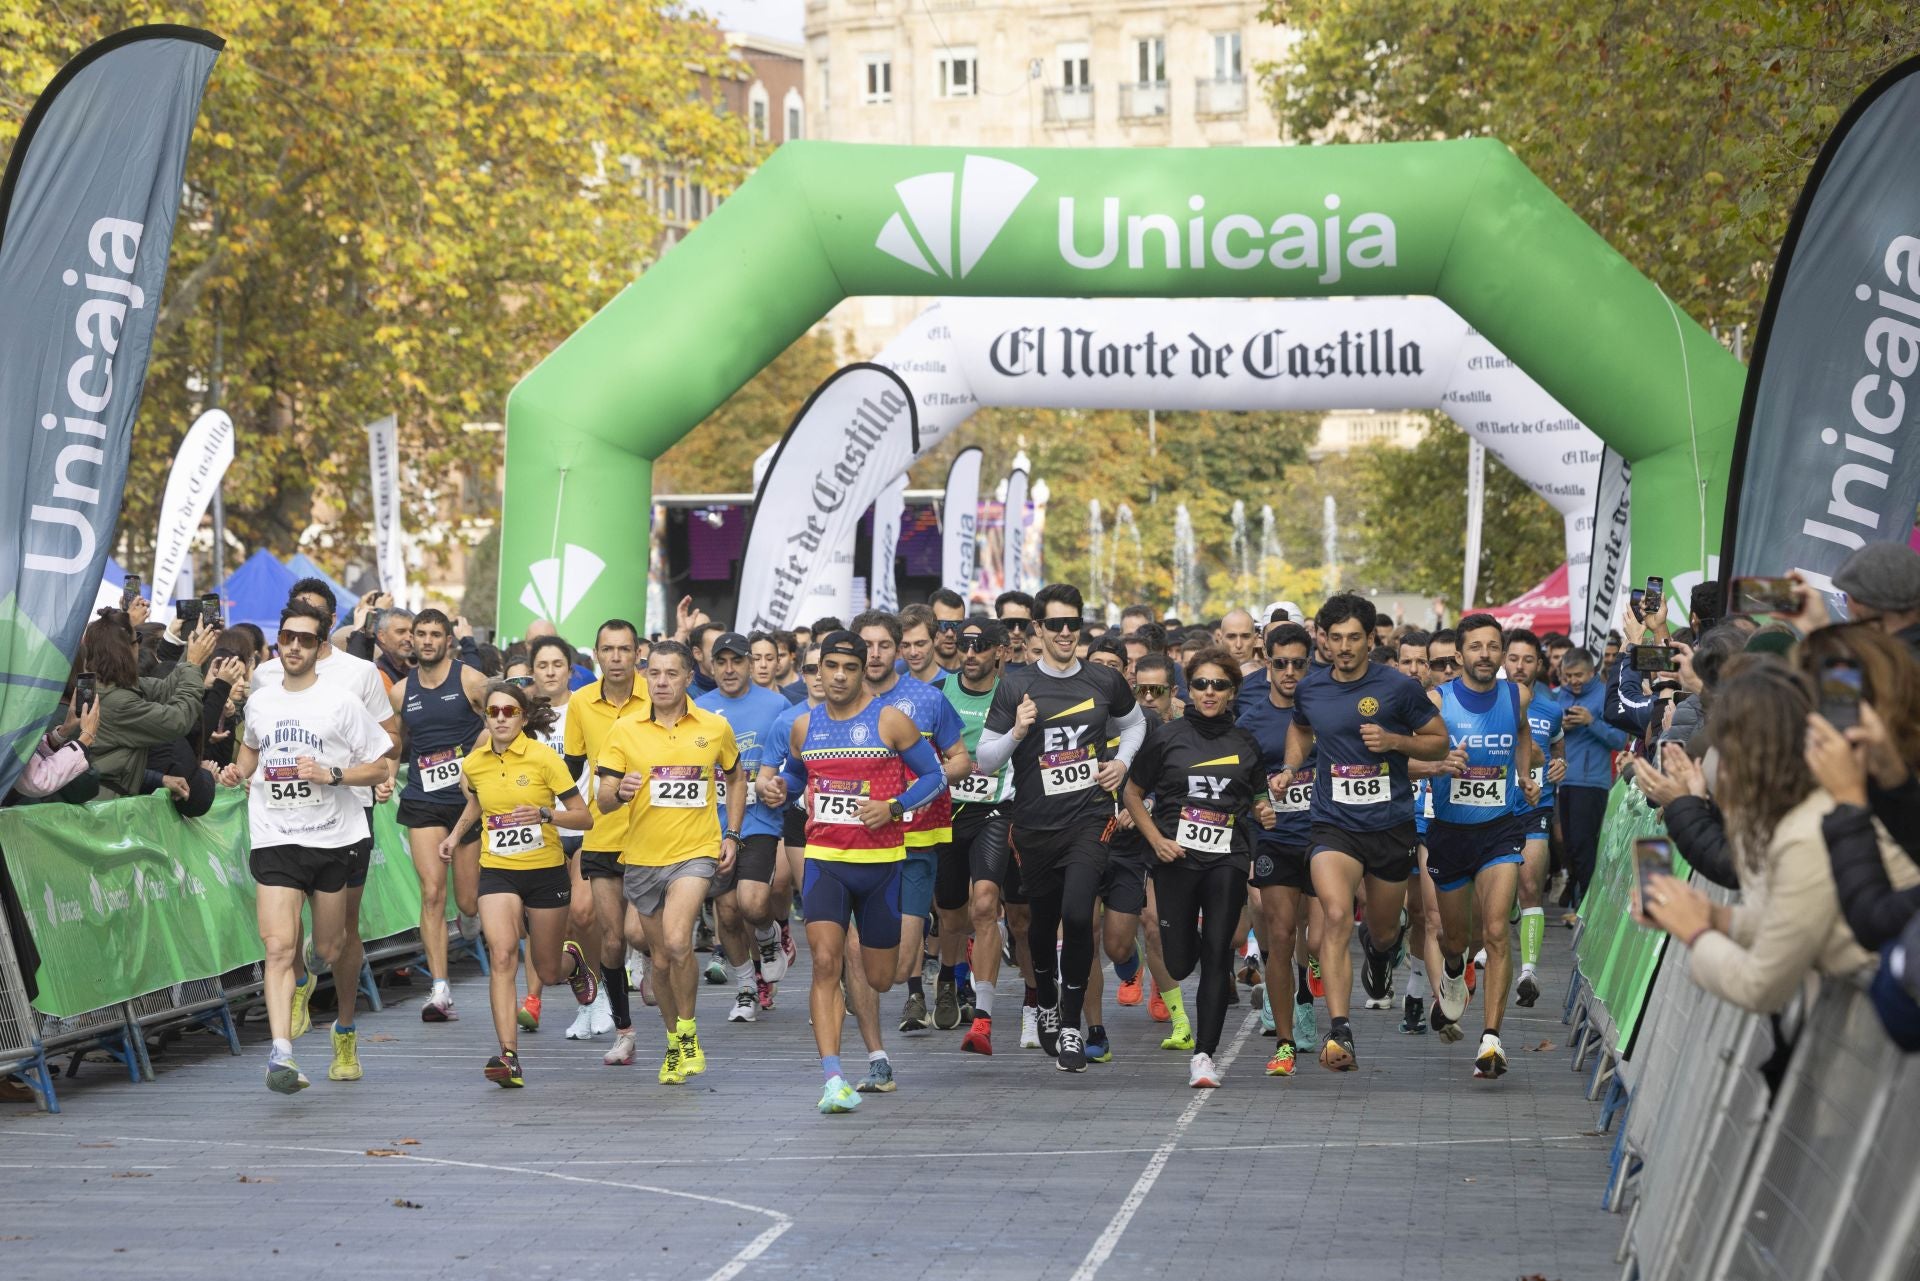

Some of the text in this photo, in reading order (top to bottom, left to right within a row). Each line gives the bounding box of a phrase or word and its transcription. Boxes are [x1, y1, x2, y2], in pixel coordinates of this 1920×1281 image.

[1058, 193, 1398, 285] Unicaja
[990, 326, 1426, 380] El Norte de Castilla
[24, 216, 145, 575] Unicaja
[1449, 390, 1492, 403] Castilla
[1476, 418, 1581, 435] El Norte de Castilla
[190, 420, 231, 495] Castilla
[1562, 450, 1578, 466] El
[787, 514, 827, 554] de
[812, 388, 907, 515] Castilla
[1545, 482, 1587, 497] Castilla
[1593, 529, 1622, 622] Norte
[1612, 490, 1630, 527] de
[275, 719, 301, 729] HOSPITAL
[274, 727, 325, 755] HORTEGA
[1044, 724, 1090, 753] EY
[1050, 754, 1058, 763] 9ª
[426, 762, 460, 783] 789
[1050, 763, 1092, 786] 309
[271, 781, 312, 801] 545
[658, 782, 700, 800] 228
[1186, 775, 1233, 800] EY
[1340, 779, 1381, 797] 168
[1458, 781, 1499, 799] 564
[819, 795, 859, 815] 755
[1192, 809, 1201, 817] 9ª
[495, 827, 534, 849] 226
[1185, 823, 1226, 845] 307
